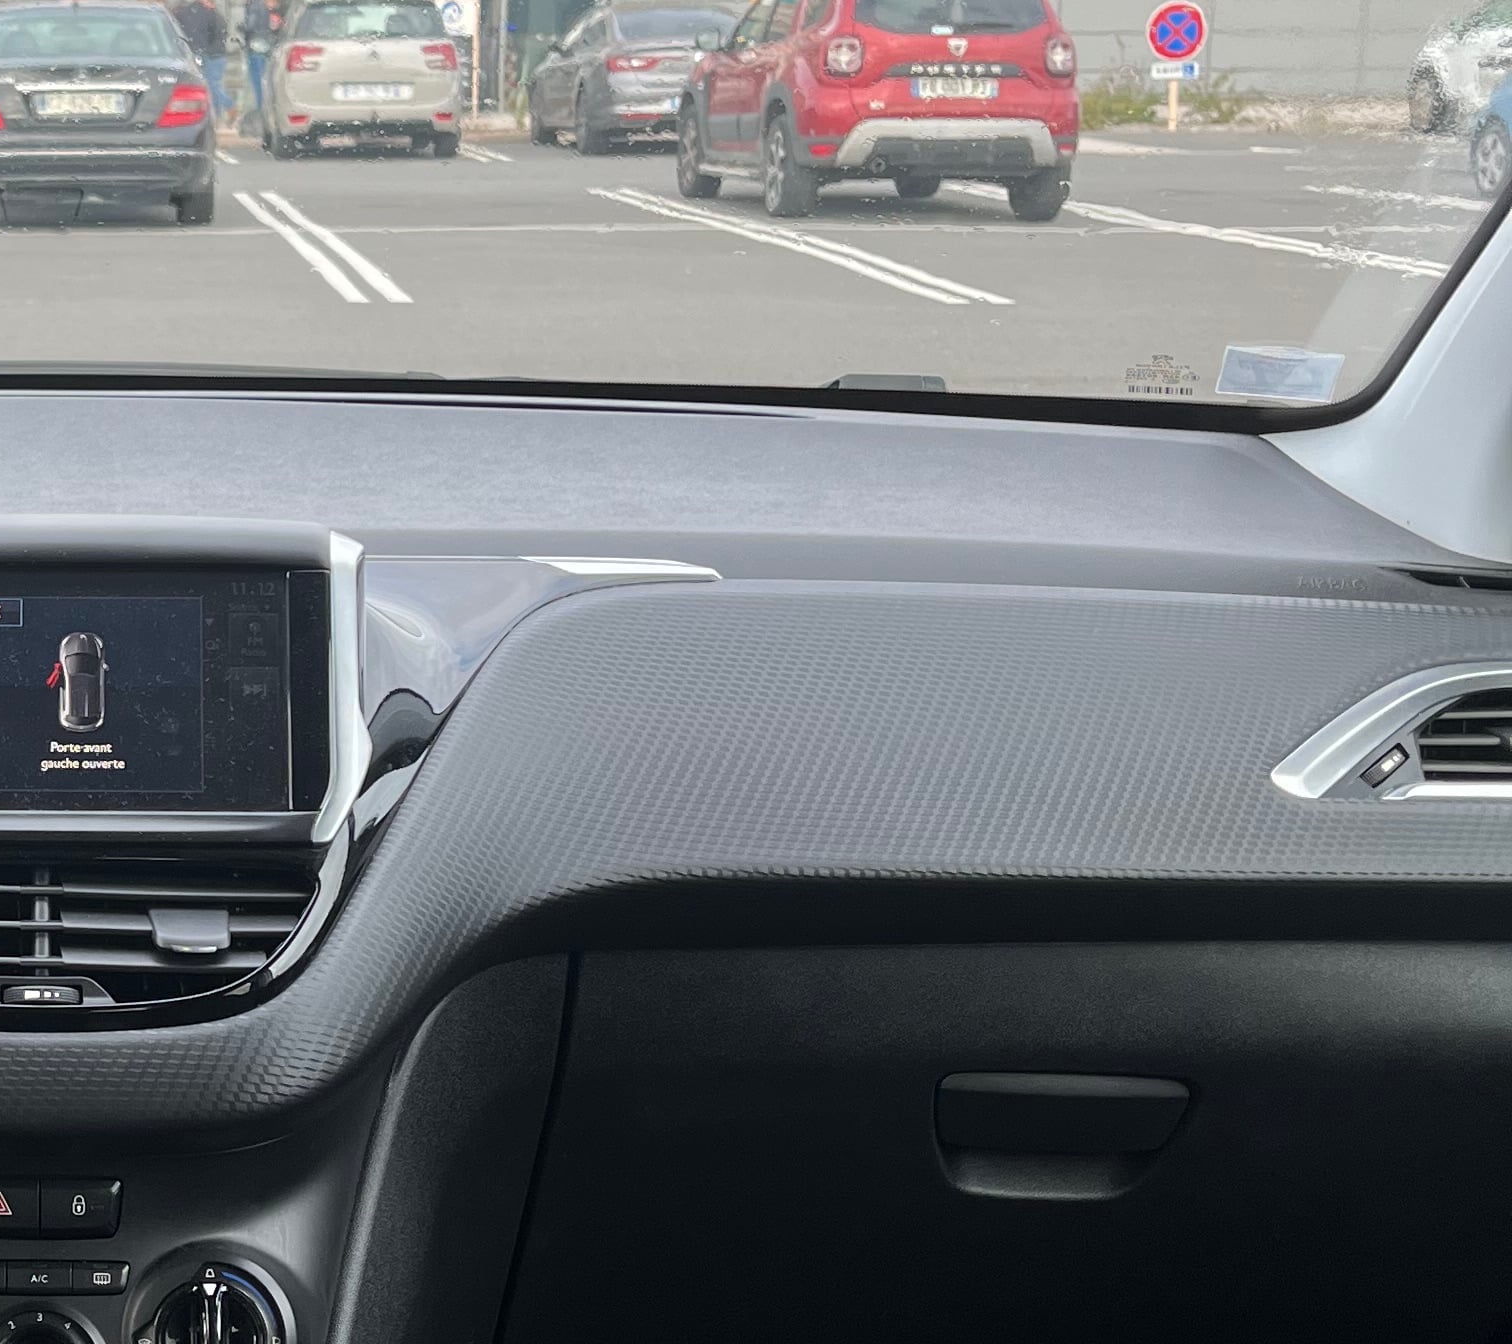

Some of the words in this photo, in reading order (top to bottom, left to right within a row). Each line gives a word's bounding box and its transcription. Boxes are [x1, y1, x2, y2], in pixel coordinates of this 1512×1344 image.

[50, 741, 81, 753] Porte
[83, 743, 113, 753] avant
[40, 757, 80, 772] gauche
[81, 760, 126, 769] ouverte
[30, 1274, 49, 1284] A/C
[36, 1312, 43, 1322] 3
